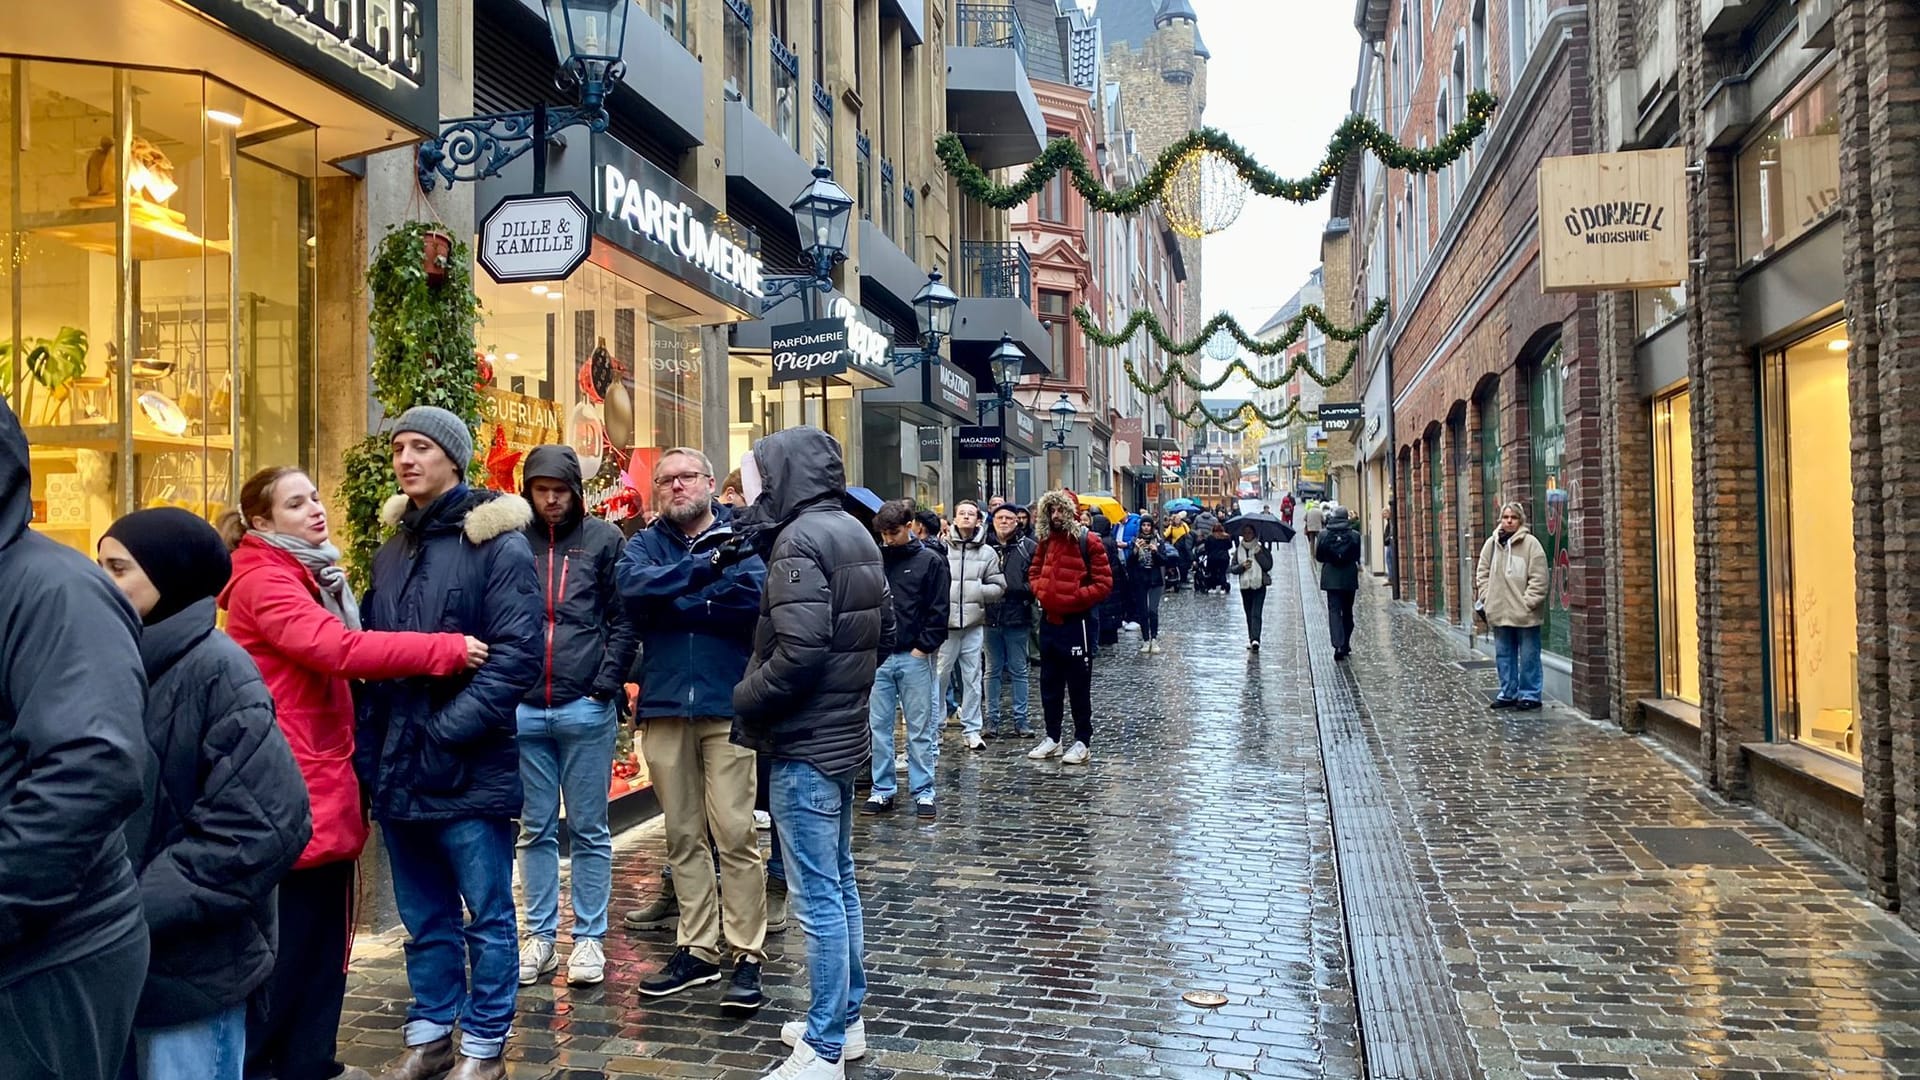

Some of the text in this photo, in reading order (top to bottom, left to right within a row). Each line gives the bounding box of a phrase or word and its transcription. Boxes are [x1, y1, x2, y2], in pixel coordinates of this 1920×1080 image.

[502, 218, 570, 237] DILLE &
[604, 164, 764, 298] PARFÜMERIE
[1586, 229, 1651, 244] MOONSHINE
[496, 236, 573, 255] KAMILLE
[773, 331, 843, 349] PARFÜMERIE
[774, 349, 843, 371] Pieper
[486, 397, 557, 431] GUERLAIN
